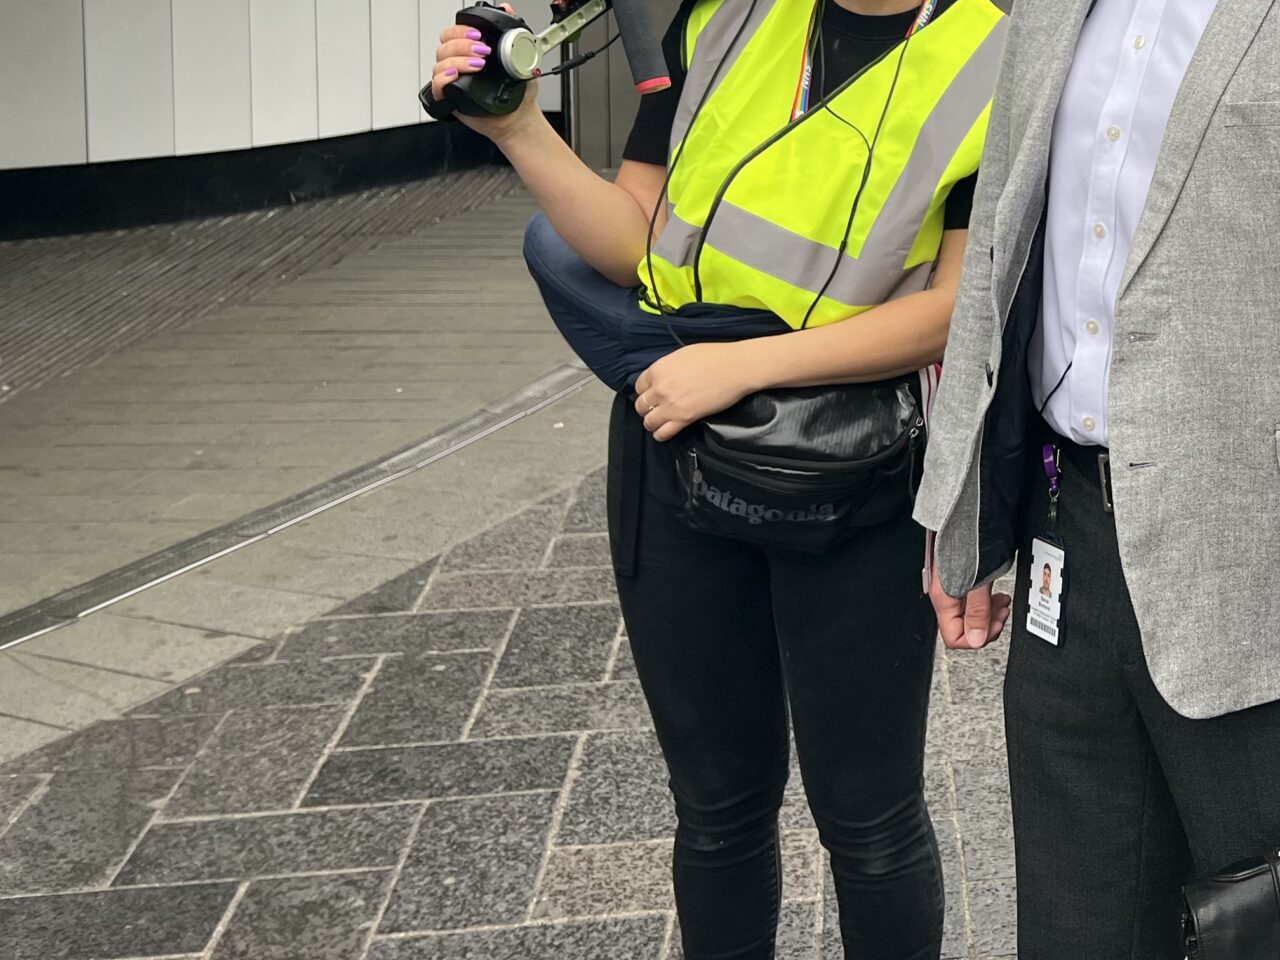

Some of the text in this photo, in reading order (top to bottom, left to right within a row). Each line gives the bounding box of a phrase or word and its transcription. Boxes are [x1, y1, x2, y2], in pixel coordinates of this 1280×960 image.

[918, 3, 933, 28] NHS
[801, 64, 812, 90] NHS
[693, 480, 836, 525] patagonia
